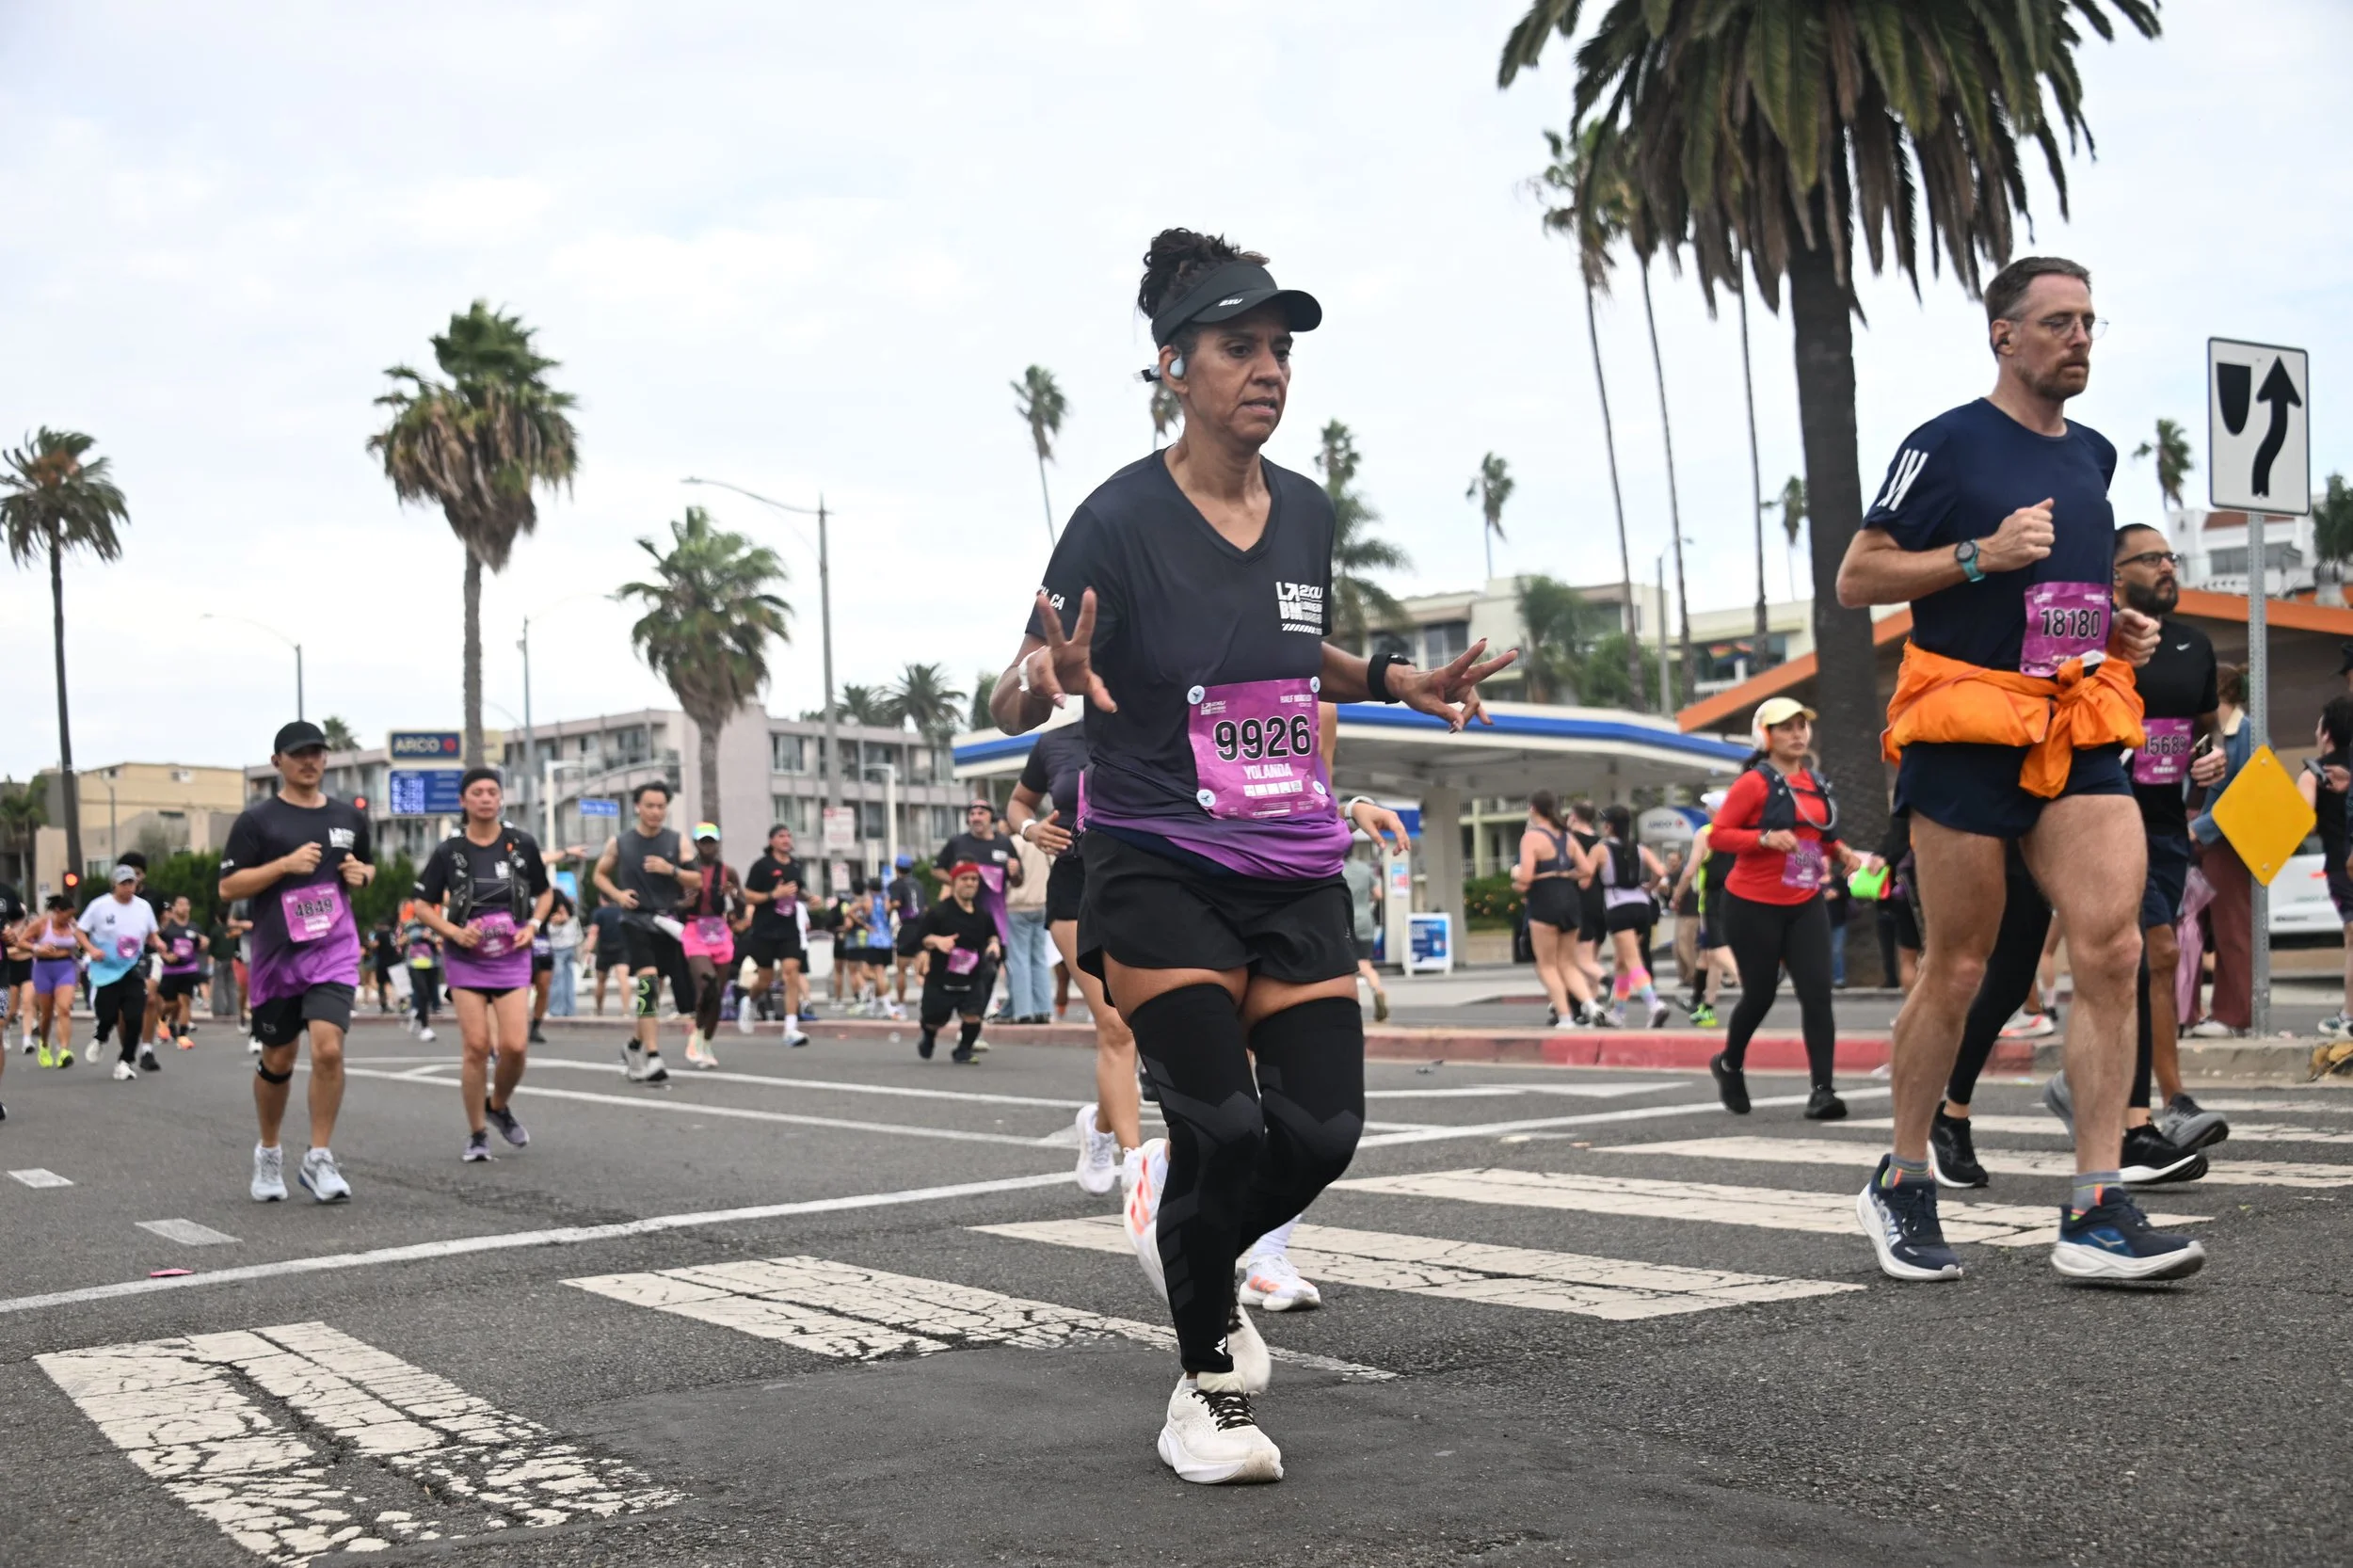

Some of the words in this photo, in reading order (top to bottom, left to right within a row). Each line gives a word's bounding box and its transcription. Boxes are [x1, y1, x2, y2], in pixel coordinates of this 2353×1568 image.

[1049, 593, 1065, 611] CA
[2040, 607, 2103, 640] 18180
[395, 737, 440, 754] ARCO
[1213, 713, 1313, 762] 9926
[1242, 763, 1294, 780] YOLANDA
[295, 898, 334, 918] 4849
